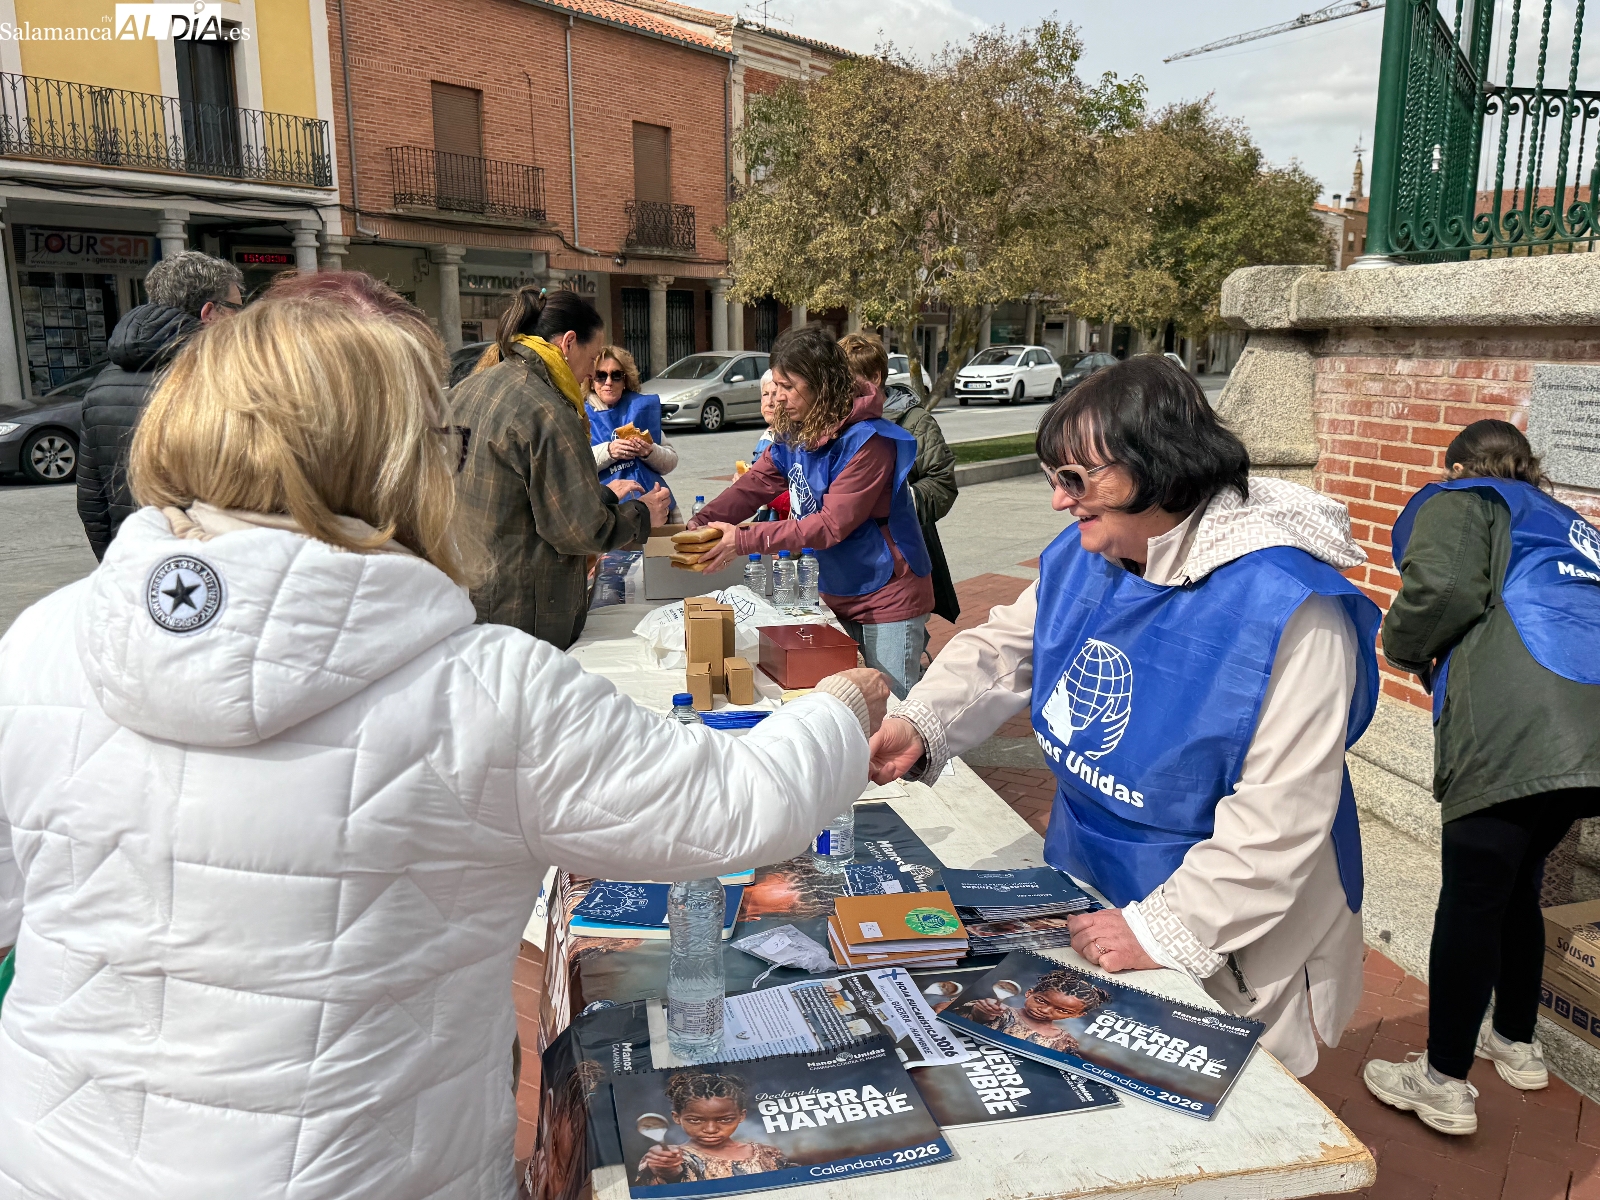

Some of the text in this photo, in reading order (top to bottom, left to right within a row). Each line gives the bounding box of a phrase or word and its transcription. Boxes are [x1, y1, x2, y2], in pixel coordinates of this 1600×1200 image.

[1065, 750, 1144, 808] Unidas
[1556, 936, 1597, 969] SOUSAS
[891, 1000, 912, 1024] GUERRA
[910, 1026, 934, 1055] HAMBRE
[895, 981, 912, 998] HOJA
[936, 1036, 960, 1058] 2026
[1095, 1014, 1209, 1060] GUERRA
[1218, 1022, 1251, 1035] Unidas
[621, 1042, 633, 1071] Manos
[806, 1048, 886, 1068] Manos Unidas
[1084, 1023, 1228, 1079] HAMBRE
[978, 1042, 1031, 1104] UERRA
[1082, 1062, 1204, 1111] Calendario 2026
[754, 1086, 821, 1102] Declara la
[757, 1084, 898, 1116] GUERRA al
[761, 1093, 915, 1134] HAMBRE
[809, 1142, 941, 1177] Calendario 2026
